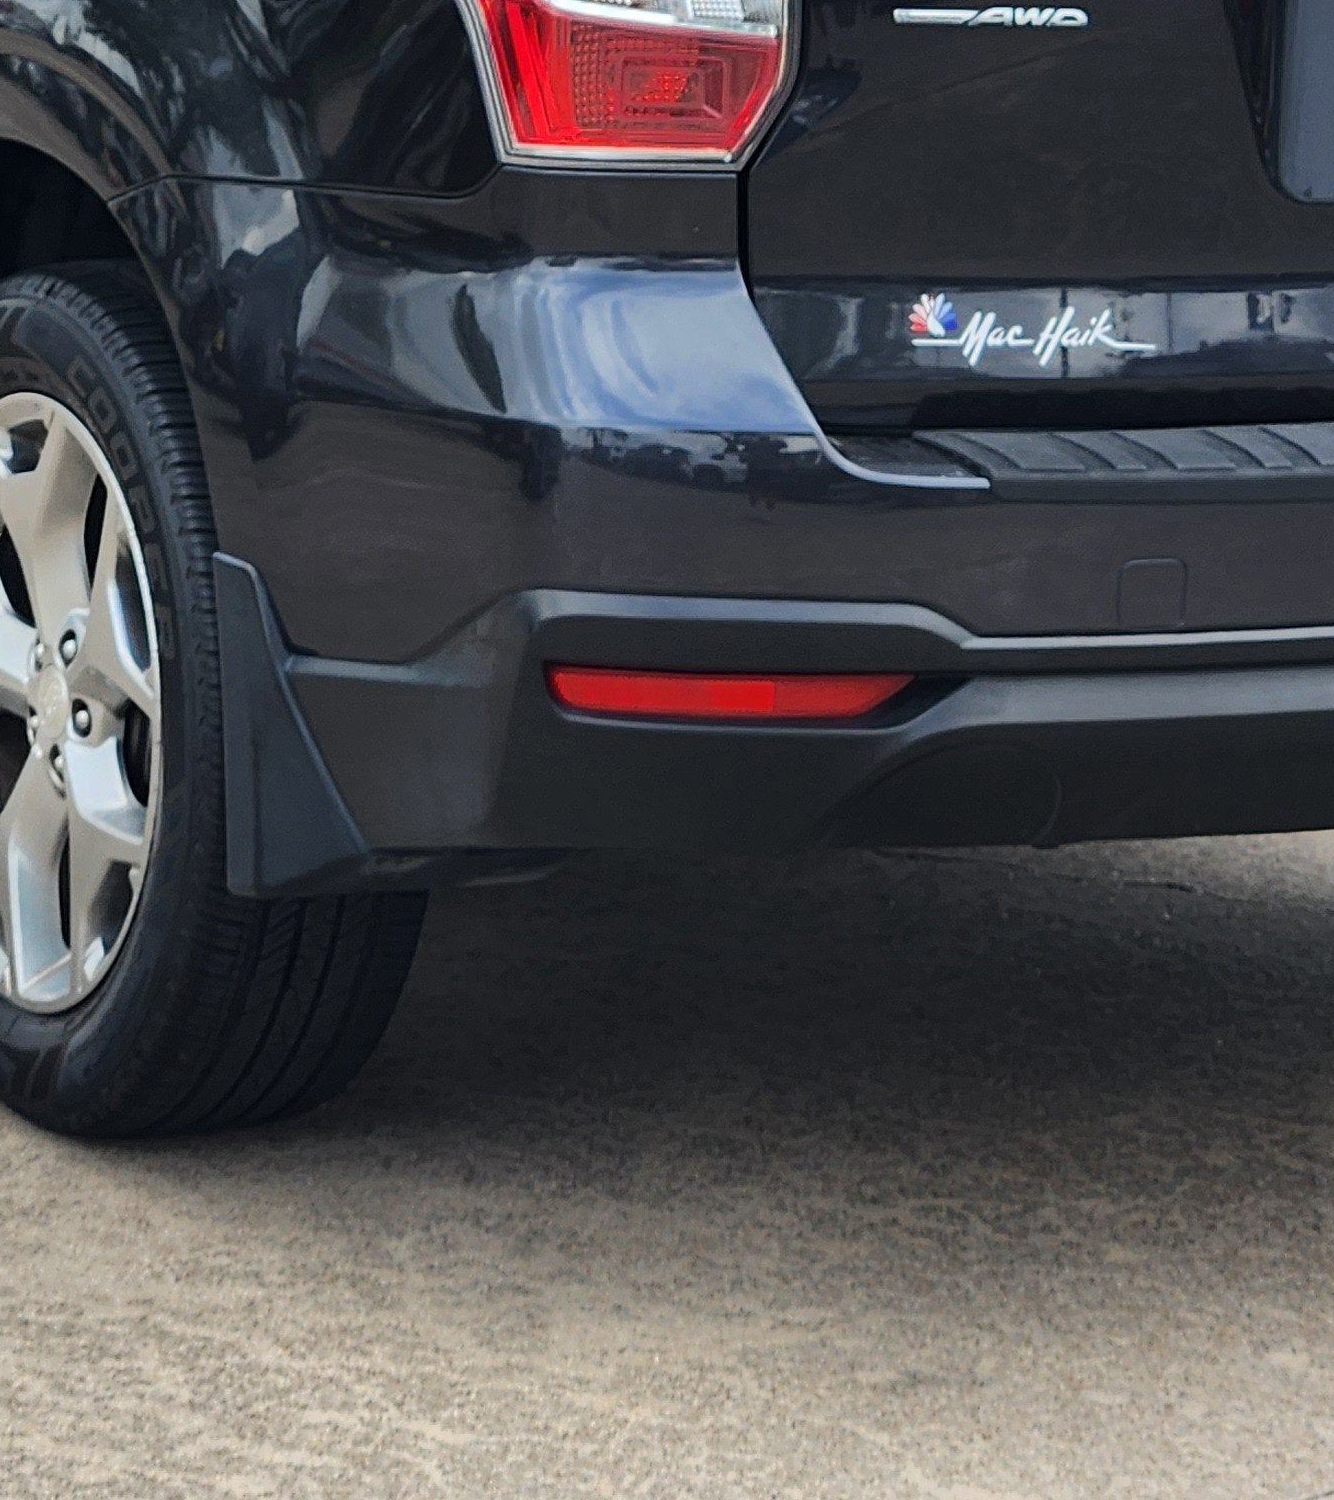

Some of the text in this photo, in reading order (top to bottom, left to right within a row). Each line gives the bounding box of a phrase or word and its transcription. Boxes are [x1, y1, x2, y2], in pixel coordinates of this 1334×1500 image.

[968, 7, 1089, 26] AWD
[958, 305, 1117, 367] Mac Haik
[67, 355, 178, 663] COOPER
